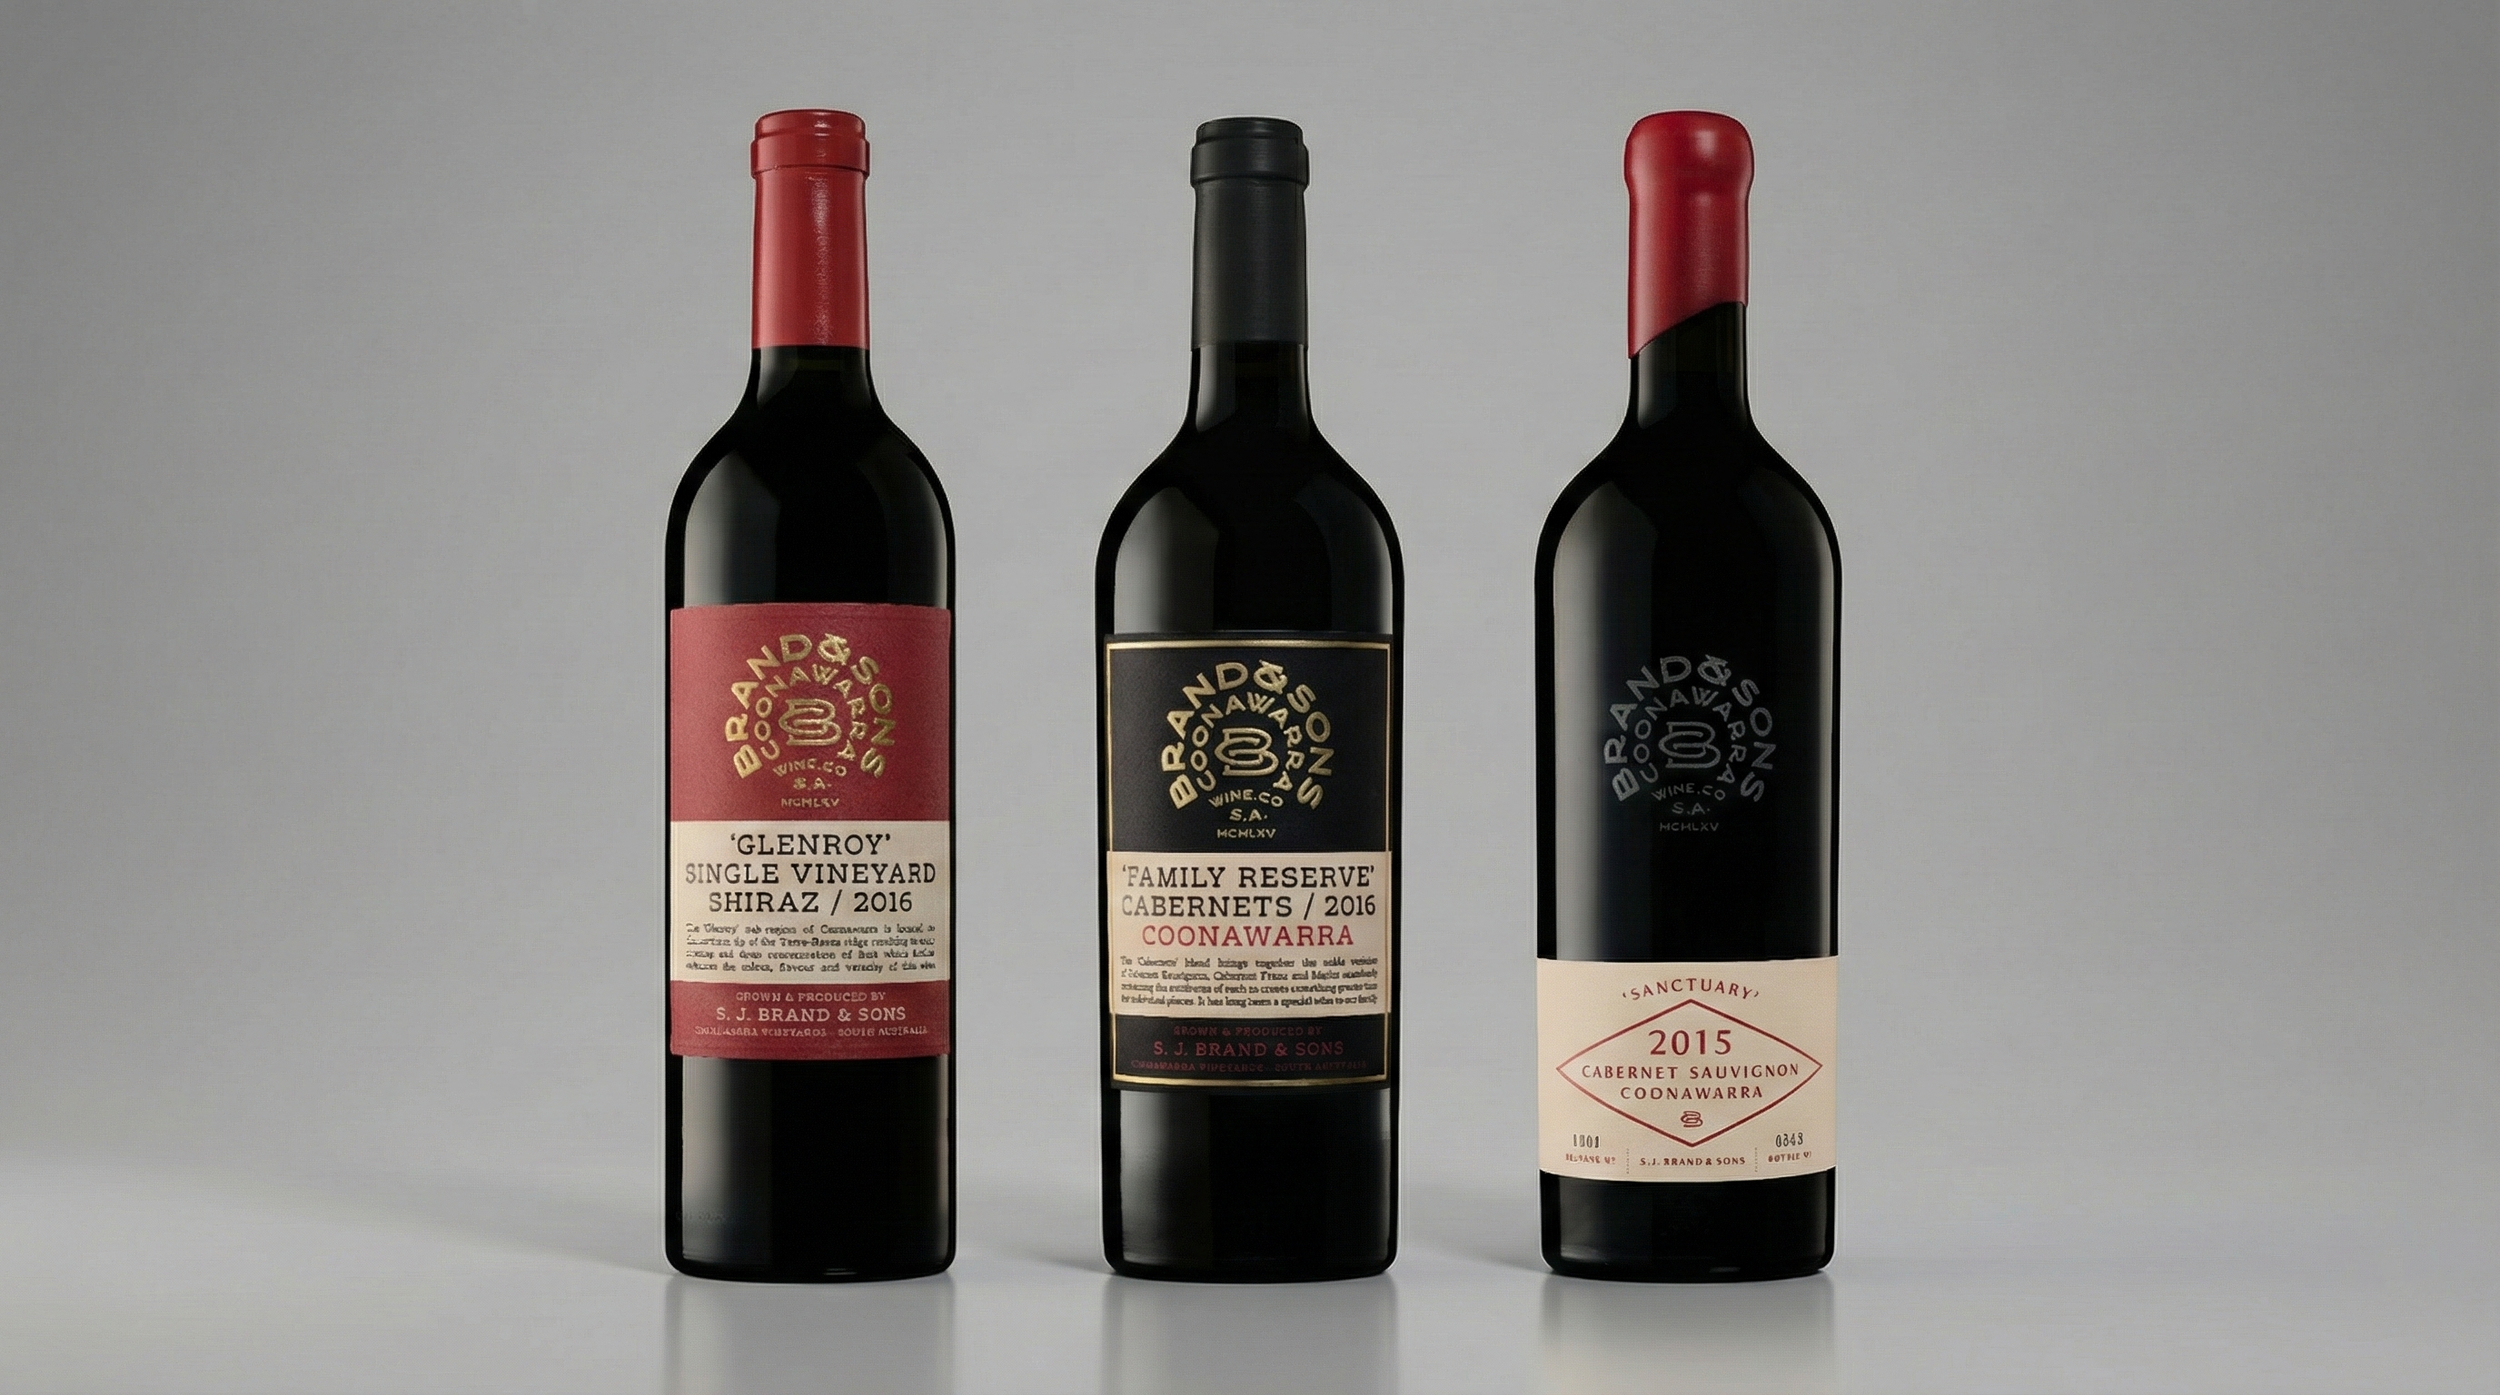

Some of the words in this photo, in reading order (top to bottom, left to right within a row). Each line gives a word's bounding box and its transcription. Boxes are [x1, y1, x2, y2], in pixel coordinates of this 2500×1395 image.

[1190, 692, 1305, 792] COONAWARRA
[1633, 686, 1747, 784] COONAWARRA
[730, 833, 892, 856] ‘GLENROY’
[685, 862, 780, 885] SINGLE
[790, 862, 937, 885] VINEYARD
[1122, 864, 1227, 888] ‘FAMILY
[1238, 865, 1375, 888] RESERVE’
[708, 891, 820, 913] SHIRAZ
[830, 889, 843, 917] /
[853, 891, 913, 913] 2016
[1121, 895, 1293, 917] CABERNETS
[1303, 892, 1315, 920] /
[1324, 894, 1376, 917] 2016
[1142, 924, 1354, 947] COONAWARRA
[758, 1008, 831, 1022] BRAND
[837, 1008, 852, 1022] &
[858, 1007, 907, 1021] SONS
[1195, 1042, 1268, 1057] BRAND
[1275, 1042, 1289, 1056] &
[1295, 1041, 1345, 1056] SONS
[1648, 1029, 1733, 1056] 2015
[1581, 1065, 1679, 1080] CABERNET
[1690, 1063, 1800, 1080] SAUVIGNON
[1620, 1086, 1764, 1100] COONAWARRA
[1716, 1157, 1746, 1166] SONS
